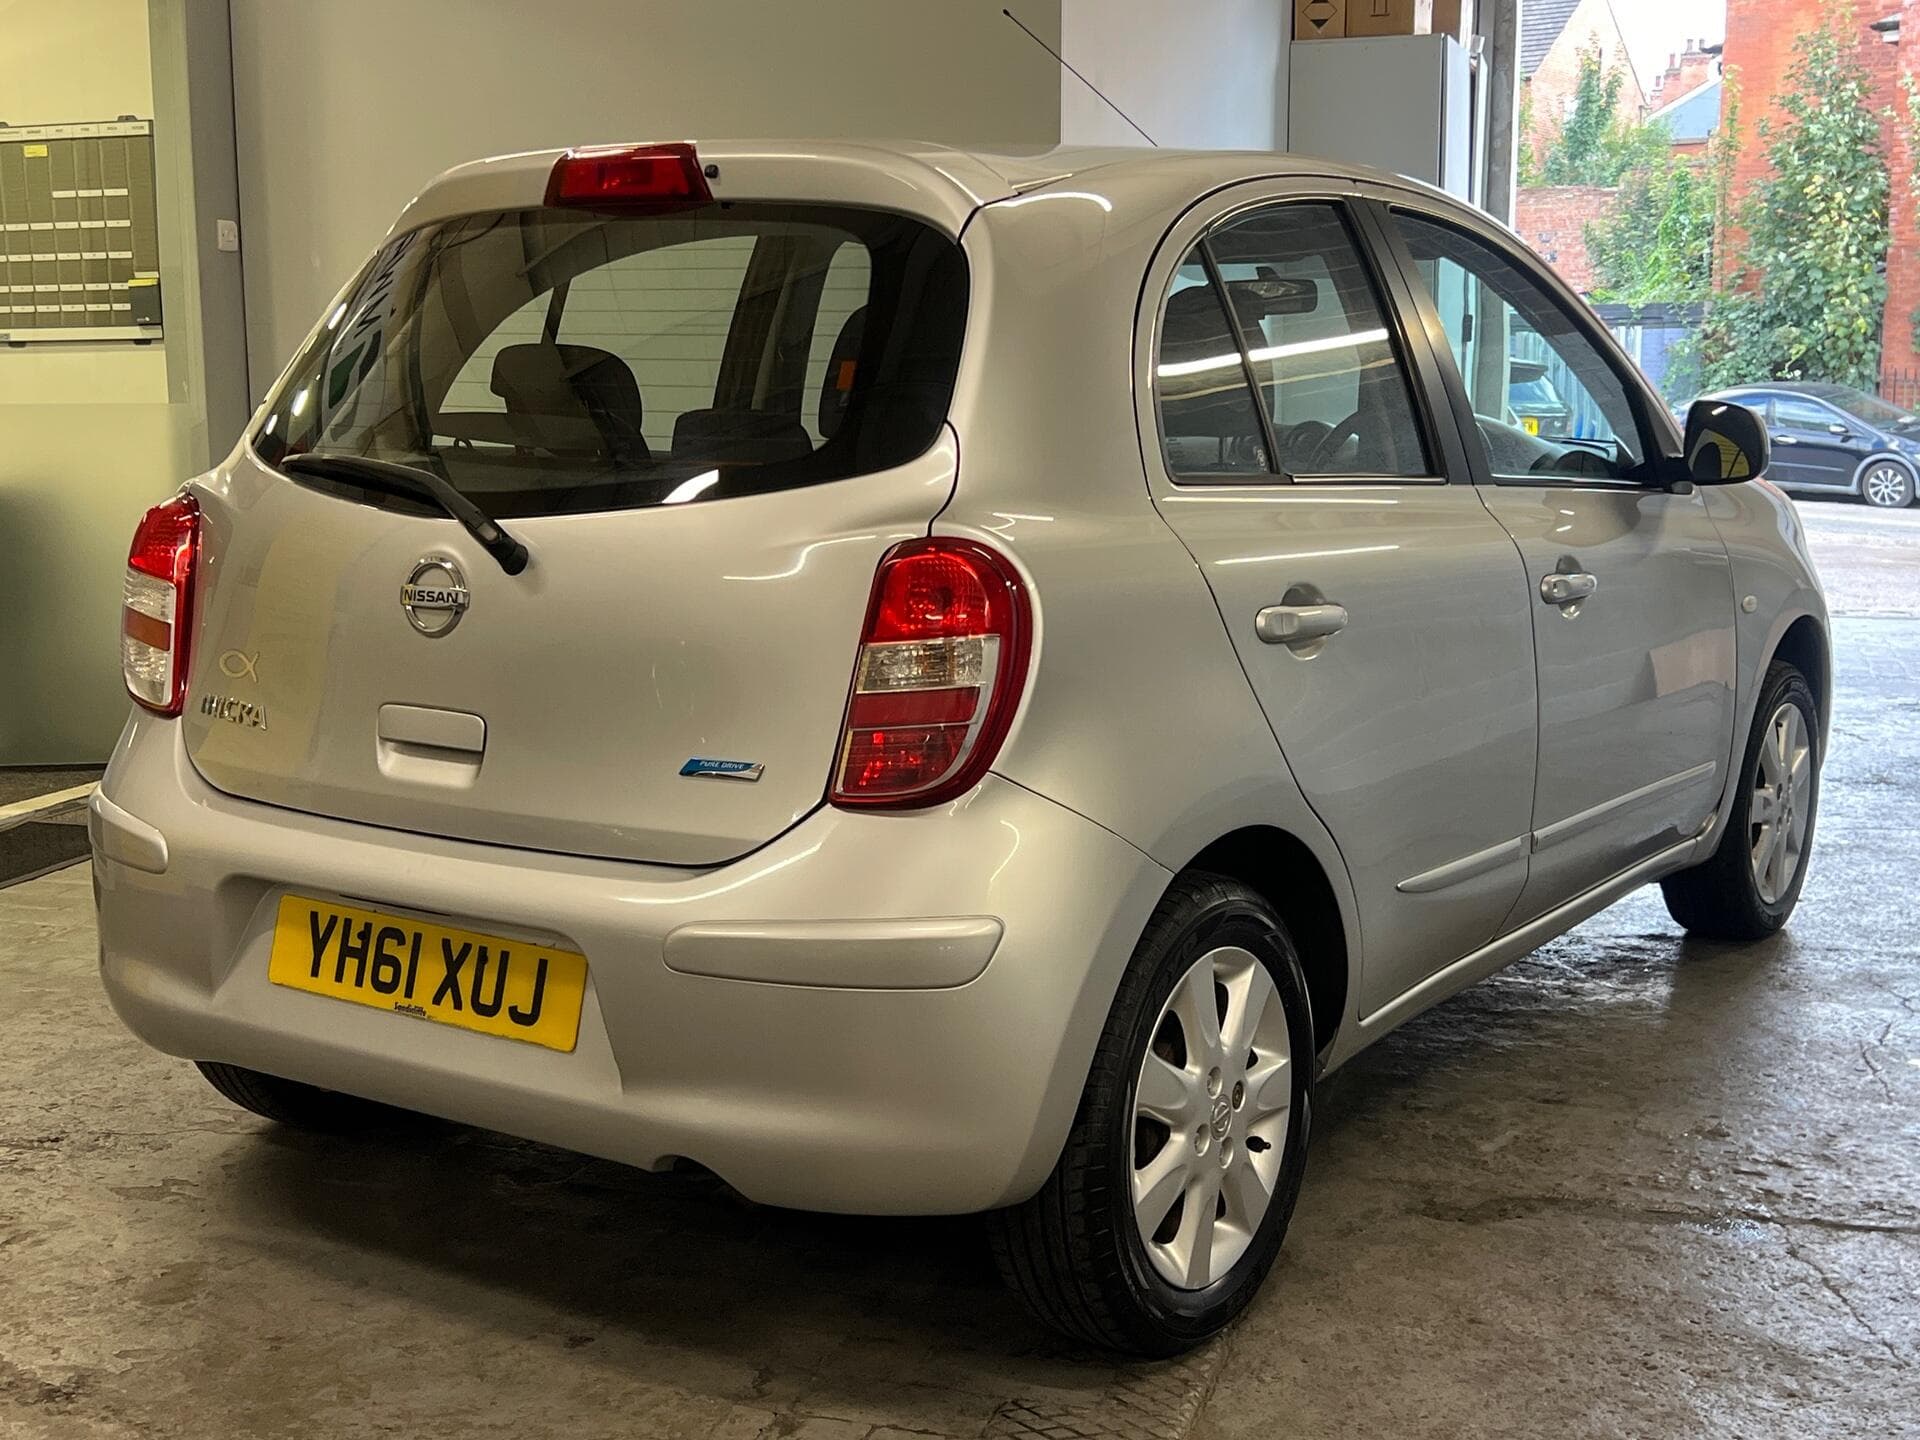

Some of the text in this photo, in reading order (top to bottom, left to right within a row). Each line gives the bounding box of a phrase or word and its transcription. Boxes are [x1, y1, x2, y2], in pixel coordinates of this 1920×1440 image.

[404, 588, 459, 604] NISSAN
[201, 694, 268, 731] MICRA
[700, 760, 744, 770] PURE DRIVE
[309, 910, 549, 1028] YH61 XUJ
